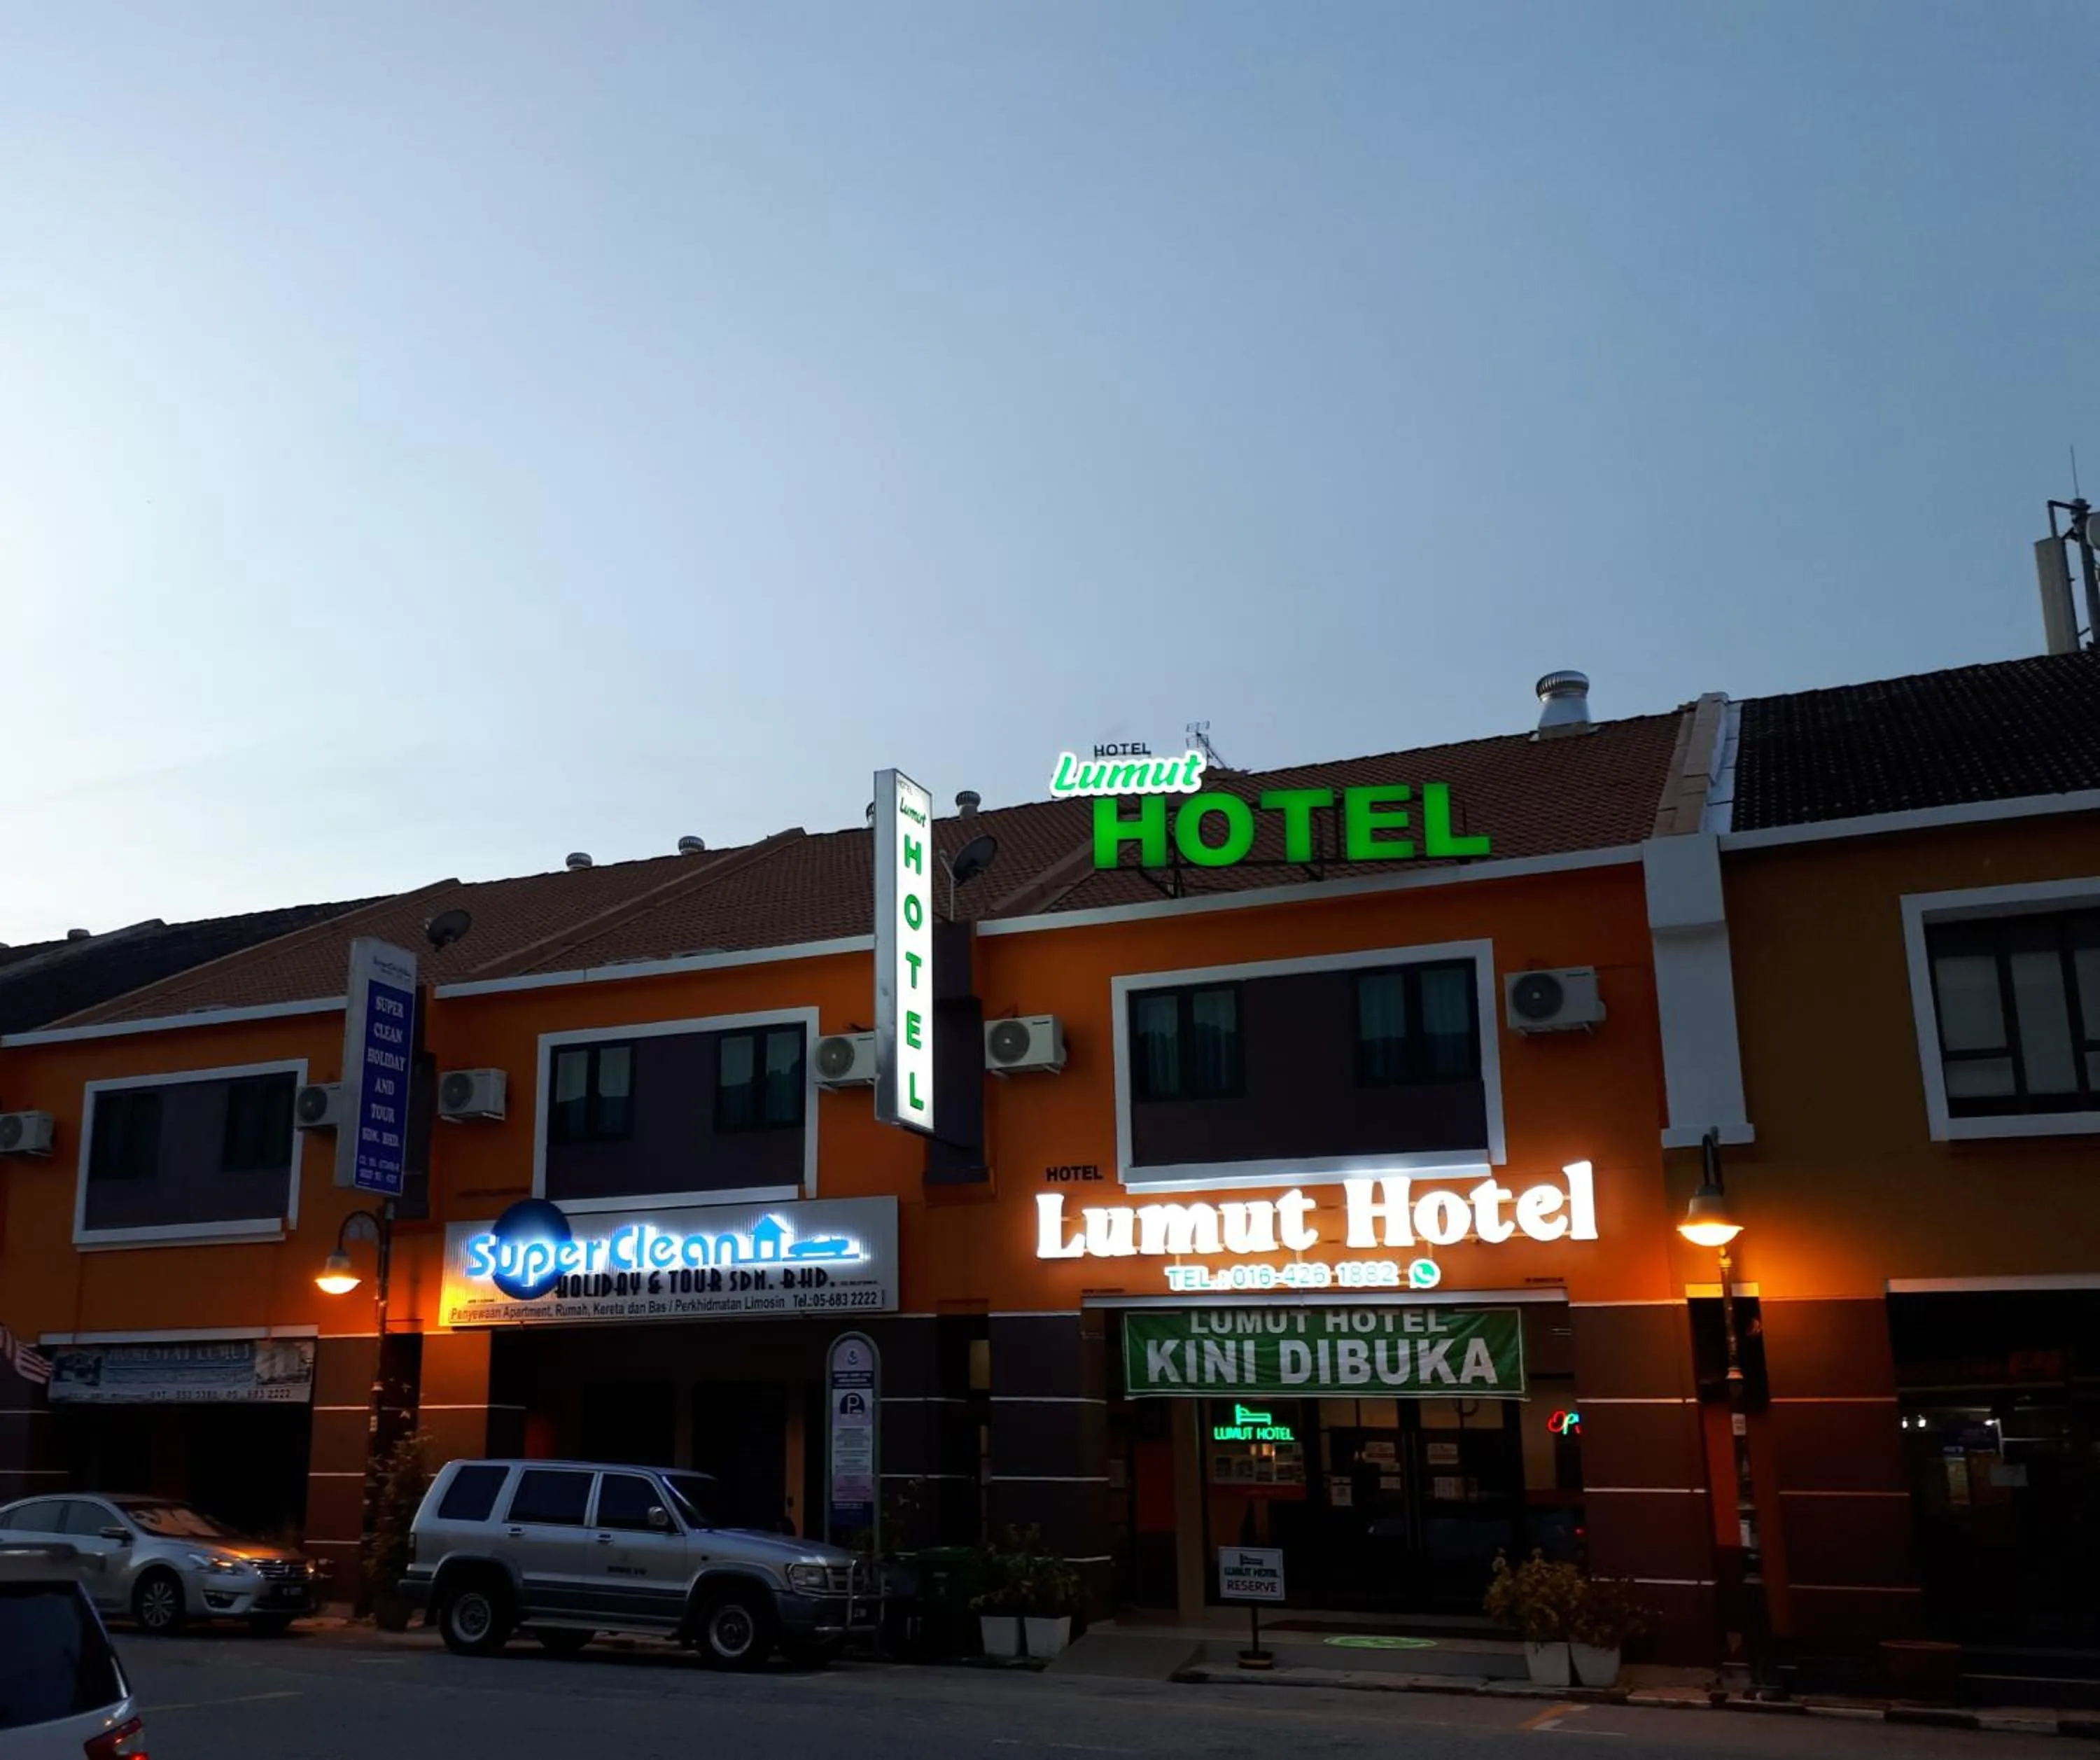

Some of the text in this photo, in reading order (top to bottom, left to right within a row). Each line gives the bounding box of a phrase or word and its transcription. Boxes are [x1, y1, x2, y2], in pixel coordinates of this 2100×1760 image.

[1094, 743, 1152, 757] HOTEL
[1052, 750, 1204, 795] Lumut
[1093, 783, 1491, 869] HOTEL
[904, 833, 924, 1111] HOTEL
[374, 996, 404, 1018] SUPER
[373, 1022, 403, 1043] CLEAN
[367, 1047, 407, 1072] HOLIDAY
[374, 1077, 395, 1096] AND
[370, 1103, 395, 1124] TOUR
[1046, 1165, 1104, 1182] HOTEL
[1035, 1160, 1599, 1259] Lumut Hotel
[555, 1272, 642, 1298] HOLIDAY
[668, 1268, 722, 1294] TOUR
[729, 1270, 774, 1292] SDN.
[779, 1266, 836, 1288] BHD.
[1338, 1262, 1398, 1287] 1882
[450, 1307, 500, 1322] Penyewaan
[594, 1302, 624, 1315] Kereta
[628, 1301, 645, 1314] dan
[649, 1301, 666, 1313] Bas
[675, 1297, 741, 1312] Perkhidmatan
[745, 1296, 785, 1309] Limosin
[850, 1291, 877, 1305] 2222
[1191, 1309, 1448, 1333] LUMUT HOTEL
[1147, 1338, 1499, 1384] KINI DIBUKA
[1256, 1426, 1295, 1441] HOTEL
[1226, 1579, 1278, 1593] RESERVE
